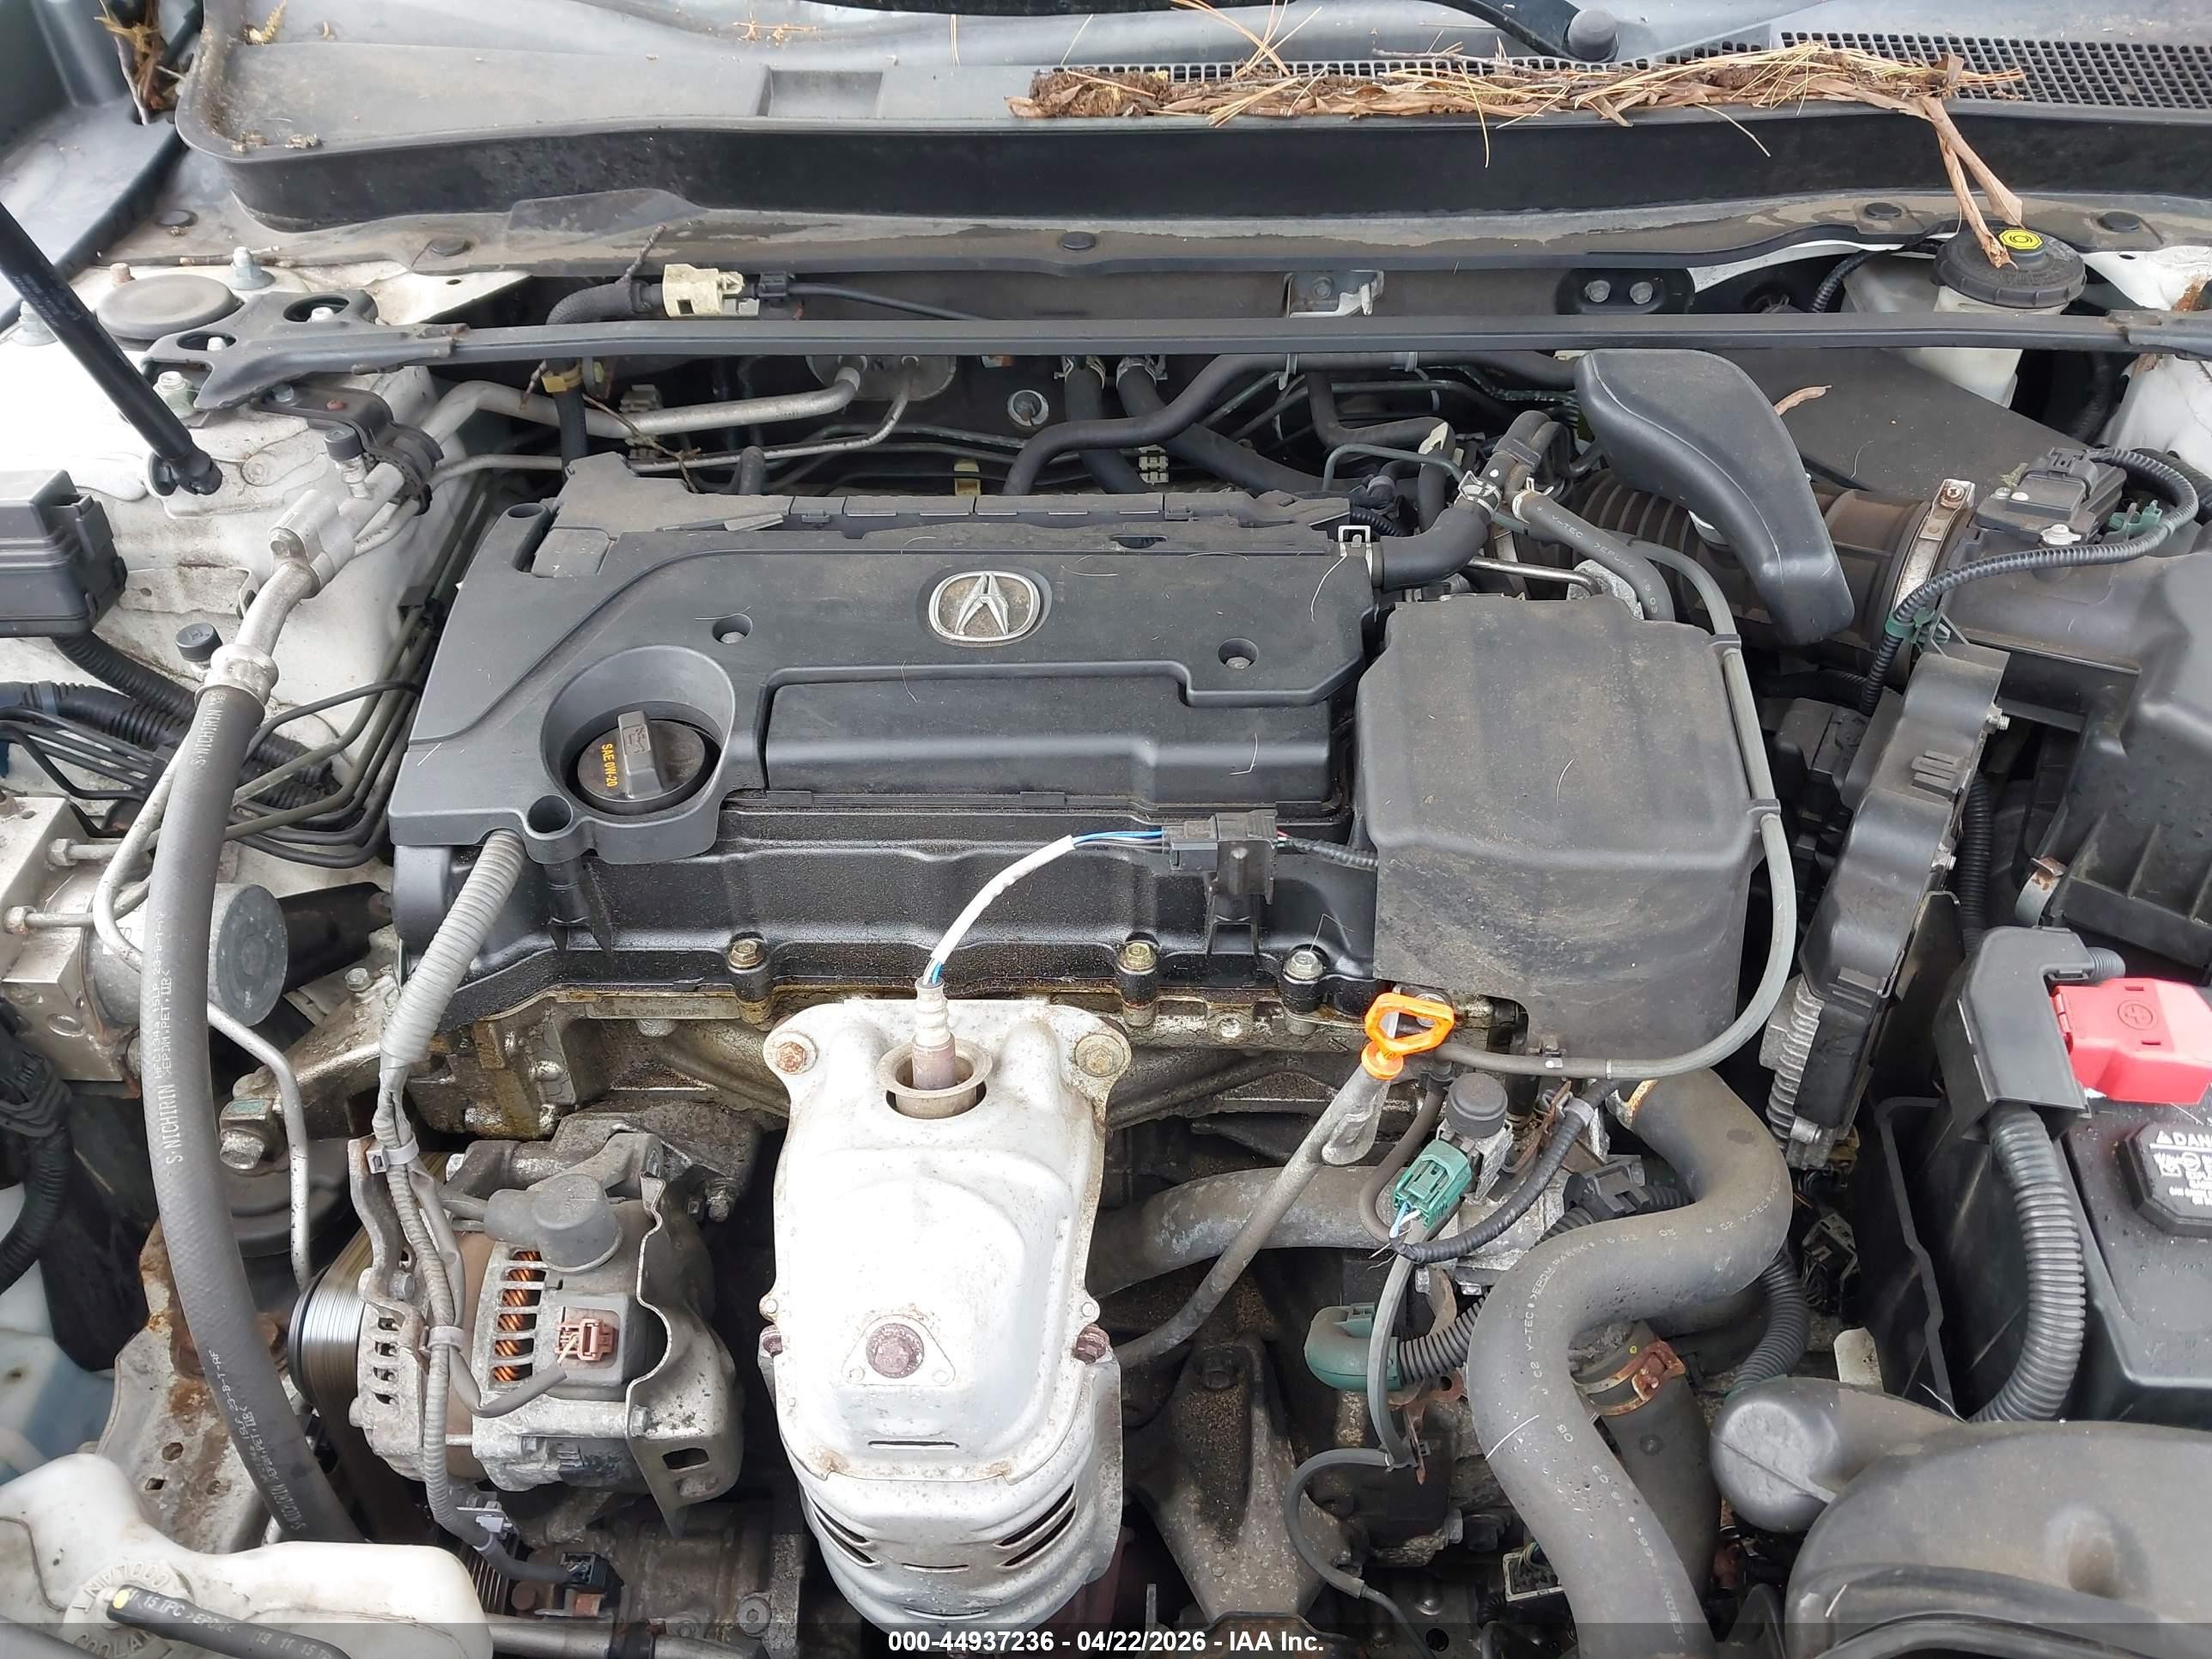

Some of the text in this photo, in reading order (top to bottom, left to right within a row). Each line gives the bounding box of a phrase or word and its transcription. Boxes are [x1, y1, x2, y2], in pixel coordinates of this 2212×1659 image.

[601, 743, 618, 787] SAE 0W-20
[1524, 1311, 1534, 1352] Y-TEC
